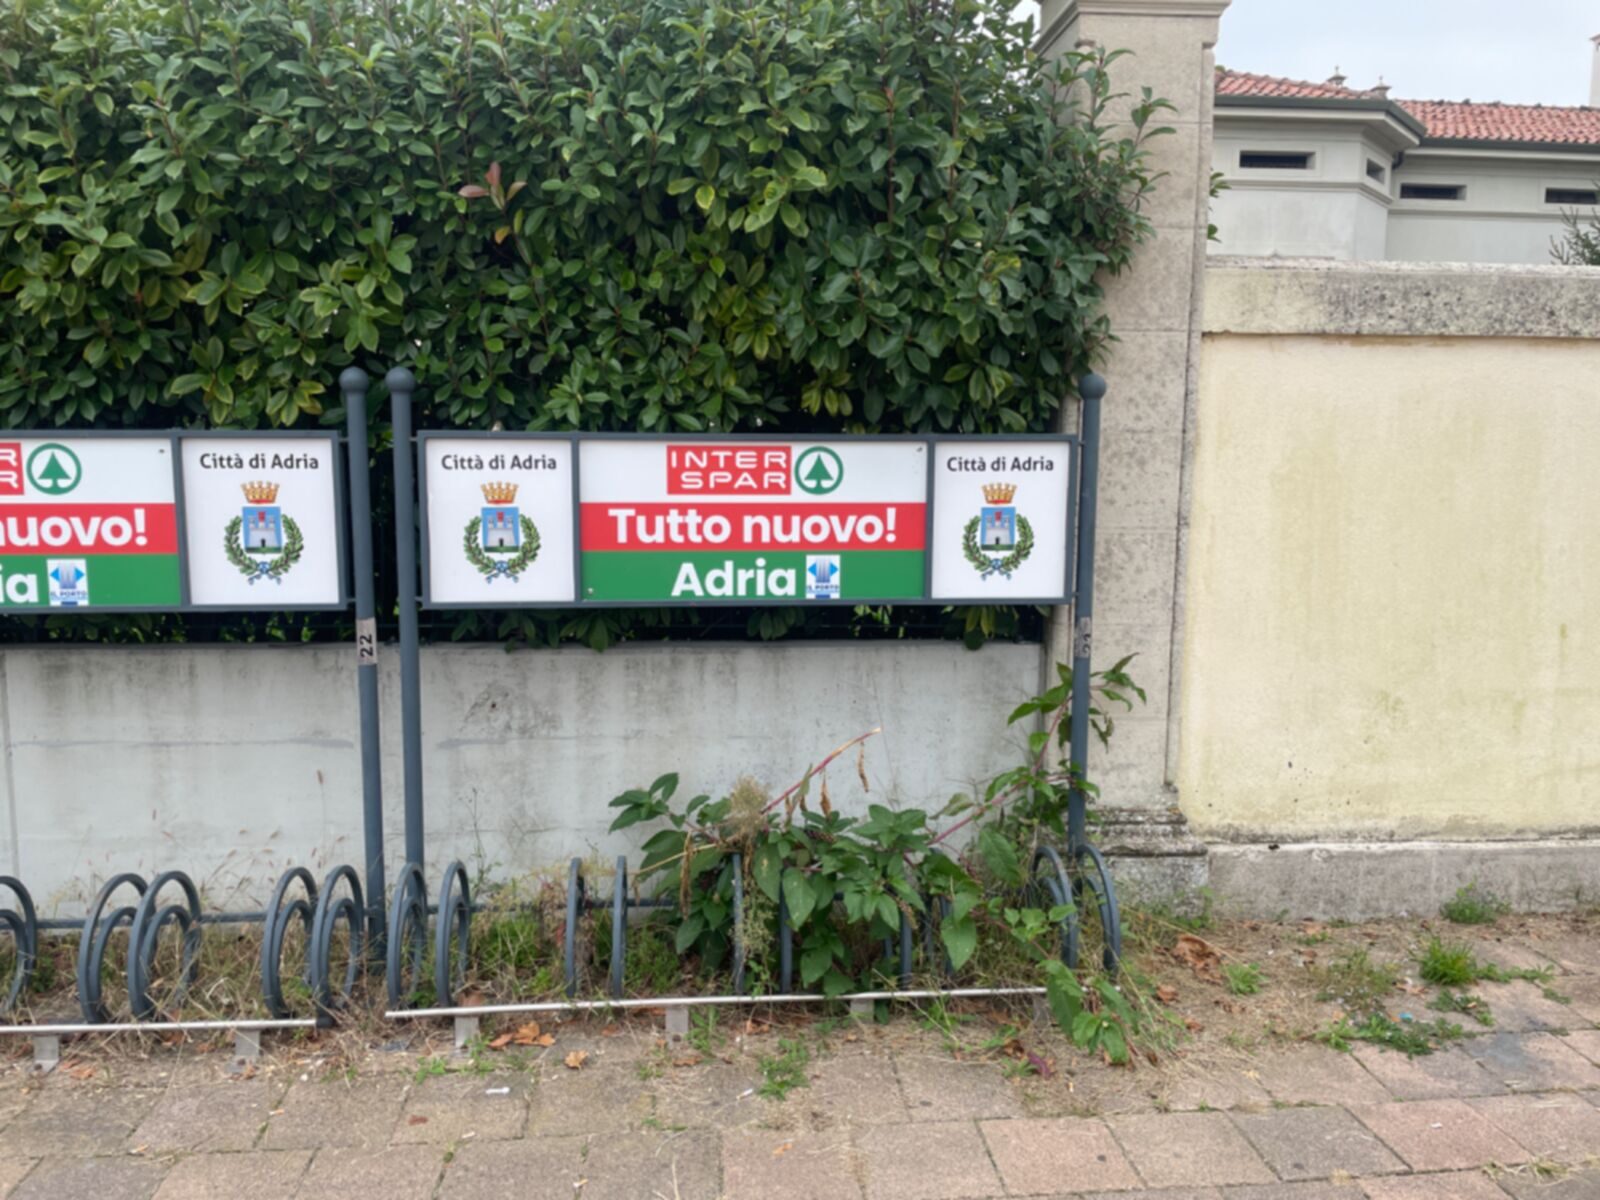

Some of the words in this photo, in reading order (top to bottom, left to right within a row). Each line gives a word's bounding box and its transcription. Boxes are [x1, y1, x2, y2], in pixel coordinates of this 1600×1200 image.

[199, 453, 244, 470] Città
[248, 453, 266, 470] di
[271, 453, 319, 470] Adria
[441, 454, 484, 471] Città
[488, 454, 505, 471] di
[510, 454, 557, 471] Adria
[670, 449, 788, 469] INTER
[946, 455, 987, 472] Città
[990, 456, 1006, 472] di
[1010, 455, 1054, 472] Adria
[679, 470, 788, 490] SPAR
[0, 507, 148, 547] uovo!
[607, 508, 732, 544] Tutto
[743, 507, 897, 544] nuovo!
[671, 557, 796, 598] Adria
[359, 633, 374, 658] 22
